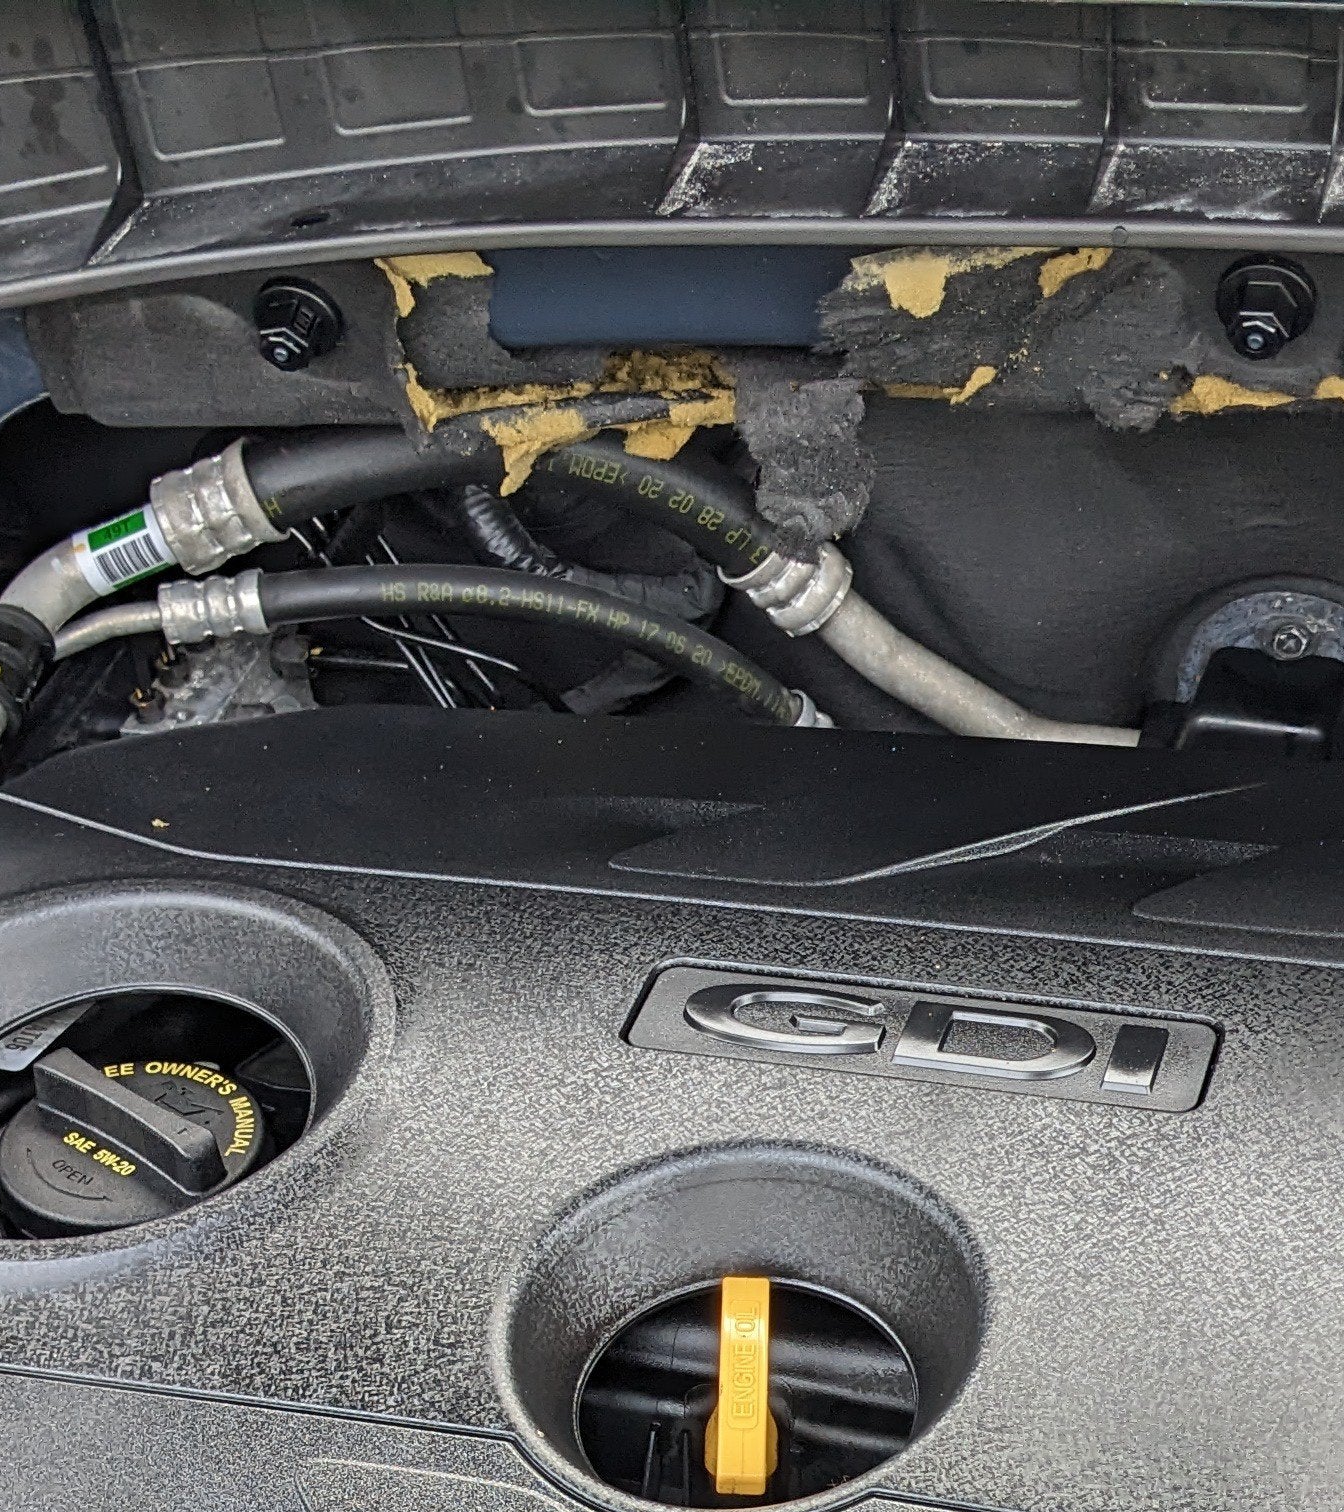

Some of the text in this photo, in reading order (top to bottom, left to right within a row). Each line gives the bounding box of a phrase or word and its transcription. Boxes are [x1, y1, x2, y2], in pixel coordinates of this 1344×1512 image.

[637, 474, 665, 499] 20
[668, 489, 695, 514] 02
[697, 505, 725, 531] 28
[682, 982, 1170, 1095] GDI
[104, 1061, 256, 1157] EE OWNER'S MANUAL
[52, 1158, 94, 1187] OPEN
[63, 1131, 137, 1178] SAE 5W-20
[732, 1306, 759, 1418] ENGINE OIL
